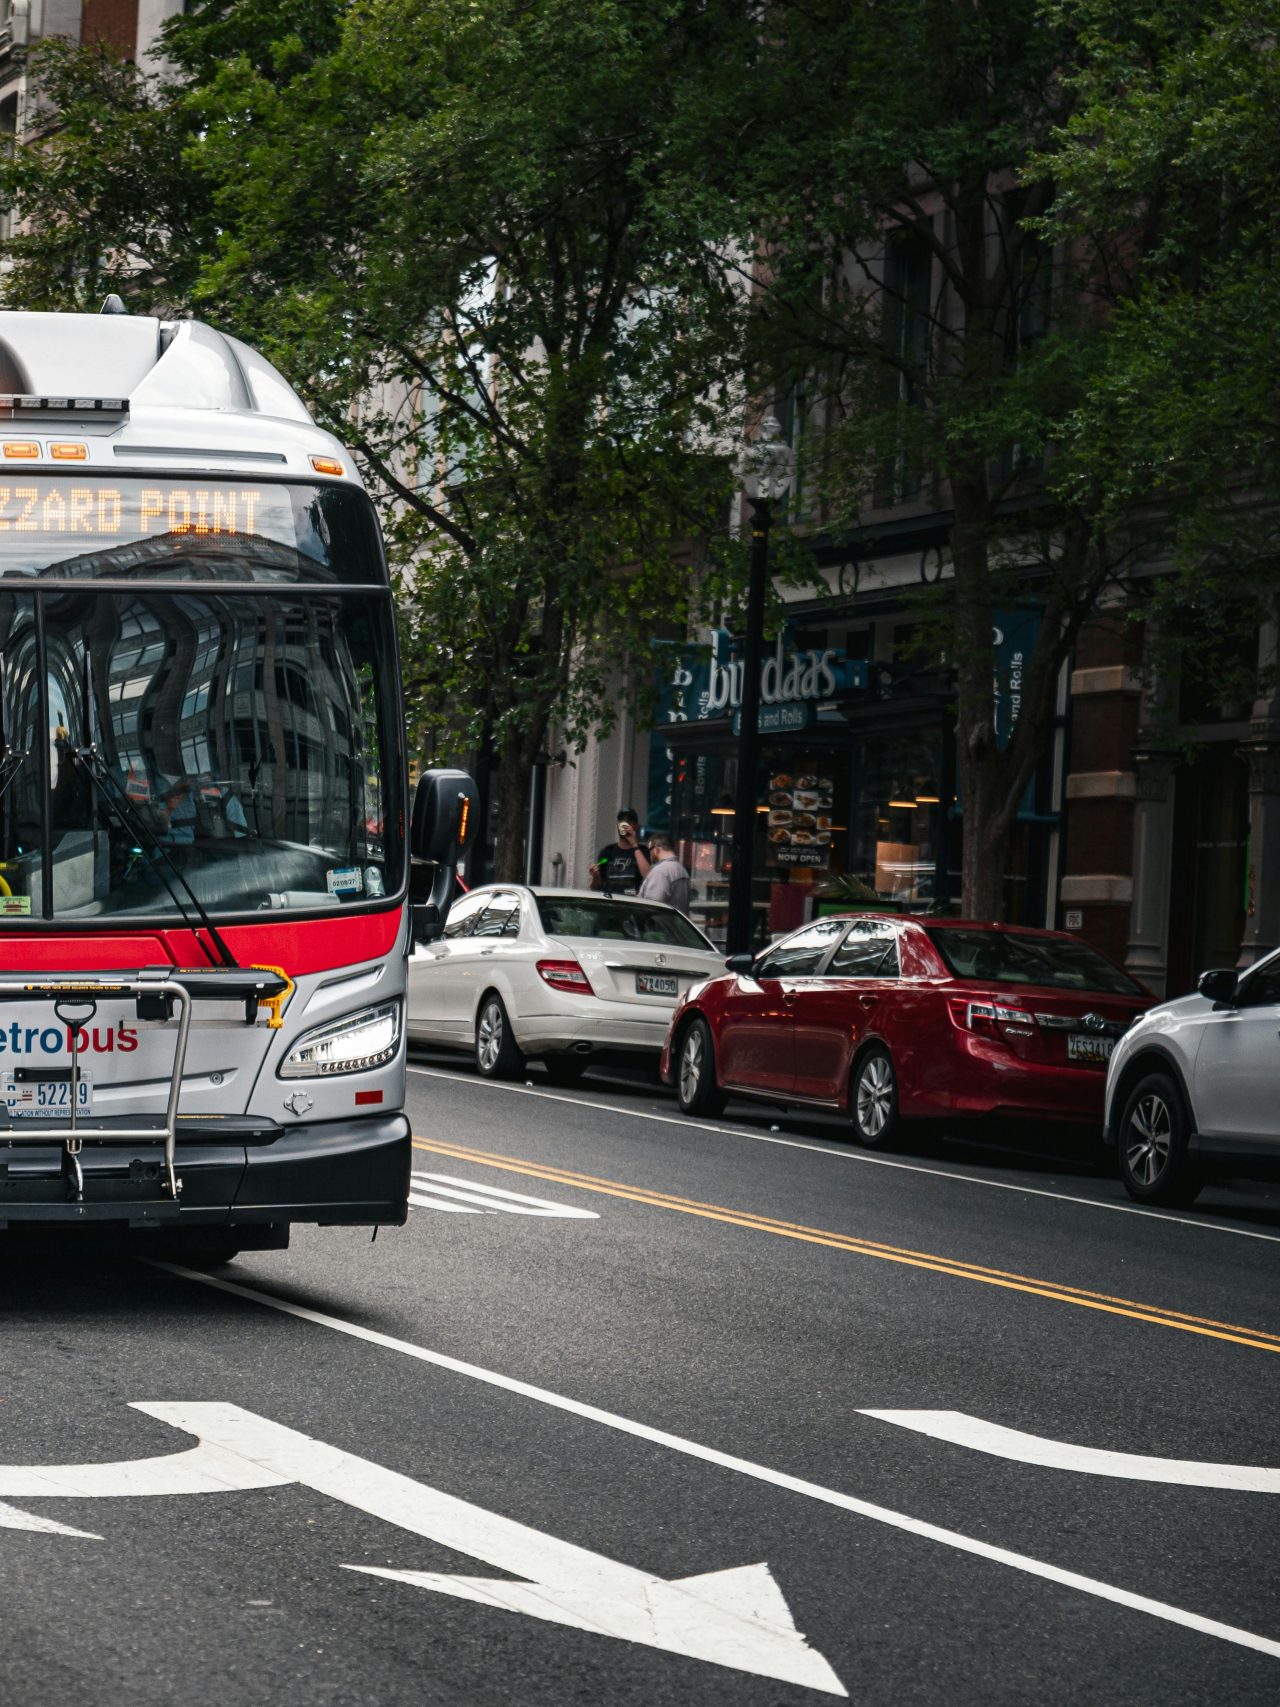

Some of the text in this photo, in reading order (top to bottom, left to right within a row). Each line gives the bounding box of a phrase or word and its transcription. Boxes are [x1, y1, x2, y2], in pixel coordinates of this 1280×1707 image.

[140, 489, 262, 535] POINT
[764, 710, 779, 727] and
[781, 709, 803, 724] Rolls
[777, 853, 821, 863] NOW OPEN
